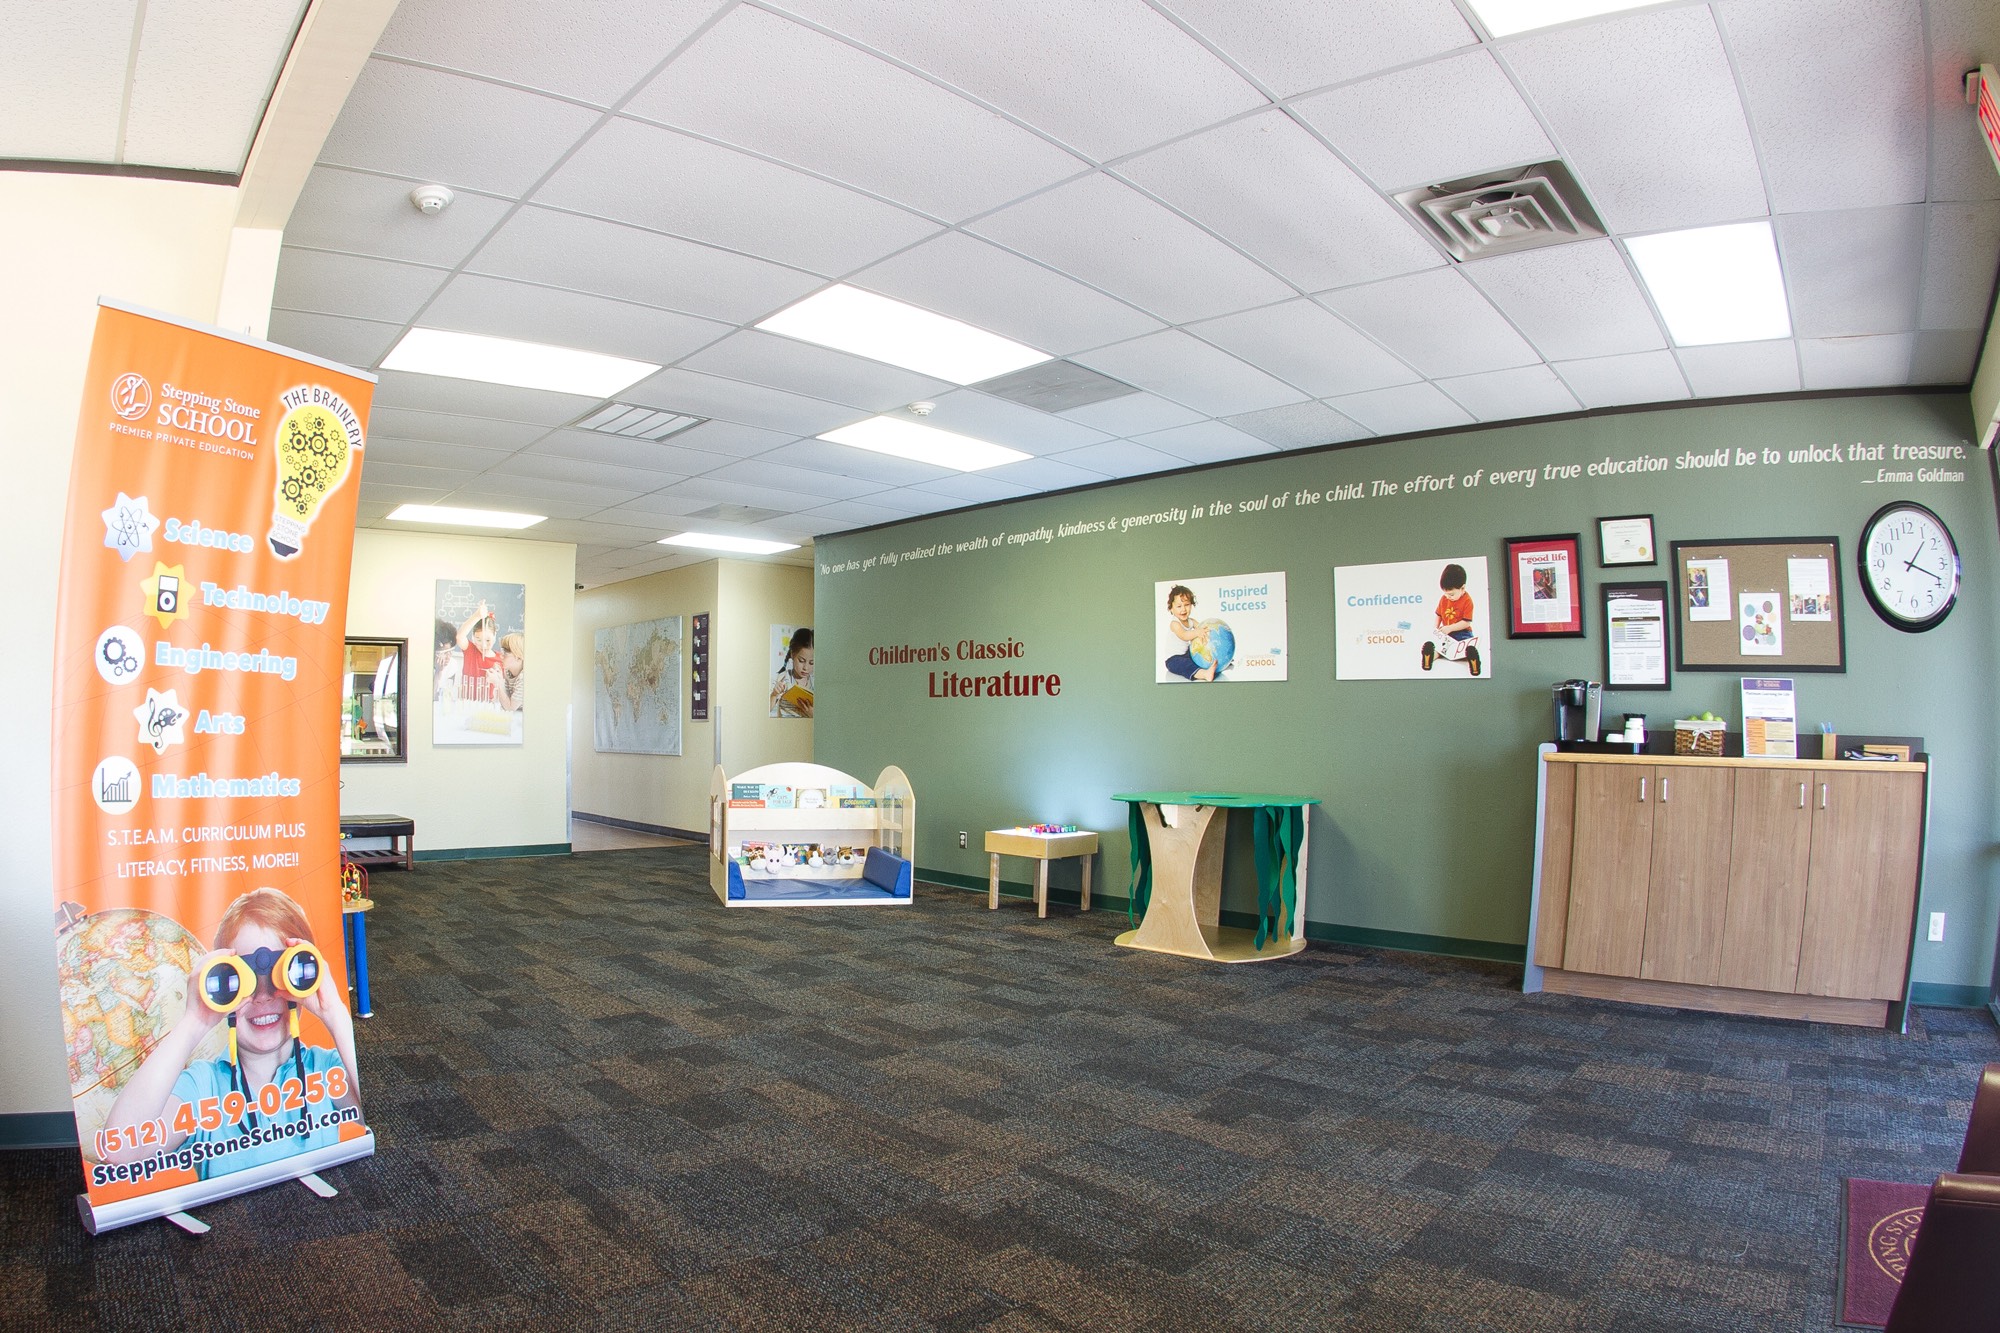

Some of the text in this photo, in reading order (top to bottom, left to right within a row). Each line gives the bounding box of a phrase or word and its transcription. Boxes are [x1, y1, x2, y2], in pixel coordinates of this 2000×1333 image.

[161, 383, 261, 419] Stepping Stone
[157, 403, 258, 446] SCHOOL
[284, 388, 362, 448] THE BRAINERY
[109, 422, 254, 461] PREMIER PRIVATE EDUCATION
[1917, 468, 1964, 483] Goldman
[832, 563, 845, 573] one
[846, 560, 860, 572] has
[862, 556, 876, 572] yet
[879, 552, 899, 567] fully
[900, 545, 935, 562] realized
[937, 543, 953, 556] the
[955, 536, 989, 553] wealth
[991, 532, 1005, 547] of
[1007, 527, 1055, 546] empathy,
[1057, 520, 1105, 538] kindness
[1107, 517, 1118, 529] &
[1121, 507, 1187, 533] generosity
[1191, 500, 1204, 519] in
[1209, 501, 1233, 517] the
[1238, 495, 1269, 513] soul
[1271, 491, 1290, 509] of
[1295, 490, 1321, 506] the
[1325, 483, 1365, 502] child.
[1371, 480, 1398, 497] The
[1403, 474, 1456, 493] effort
[1462, 469, 1484, 487] of
[1489, 467, 1537, 488] every
[1543, 463, 1582, 480] true
[1587, 455, 1668, 476] education
[1675, 448, 1729, 470] should
[1735, 448, 1756, 466] be
[1762, 447, 1781, 465] to
[1788, 444, 1843, 463] unlock
[1848, 442, 1885, 462] that
[163, 518, 254, 553] Science
[1890, 528, 1899, 540] 11
[1902, 522, 1914, 534] 12
[1527, 554, 1548, 564] good
[1552, 553, 1566, 561] life
[1881, 543, 1892, 555] 10
[200, 582, 330, 624] Technology
[1218, 584, 1268, 600] Inspired
[1347, 593, 1423, 607] Confidence
[1220, 600, 1267, 612] Success
[868, 637, 1025, 666] Children's Classic
[1367, 635, 1405, 644] SCHOOL
[155, 641, 297, 681] Engineering
[1246, 659, 1276, 667] SCHOOL
[929, 669, 1061, 698] Literature
[194, 710, 245, 735] Arts
[151, 772, 301, 799] Mathematics
[107, 822, 306, 846] S.T.E.A.M. CURRICULUM PLUS
[117, 852, 299, 879] LITERACY, FITNESS, MORE!!
[94, 1066, 349, 1161] (512) 459-0258
[91, 1106, 359, 1186] SteppingStoneSchool.com
[1886, 1211, 1924, 1236] STO
